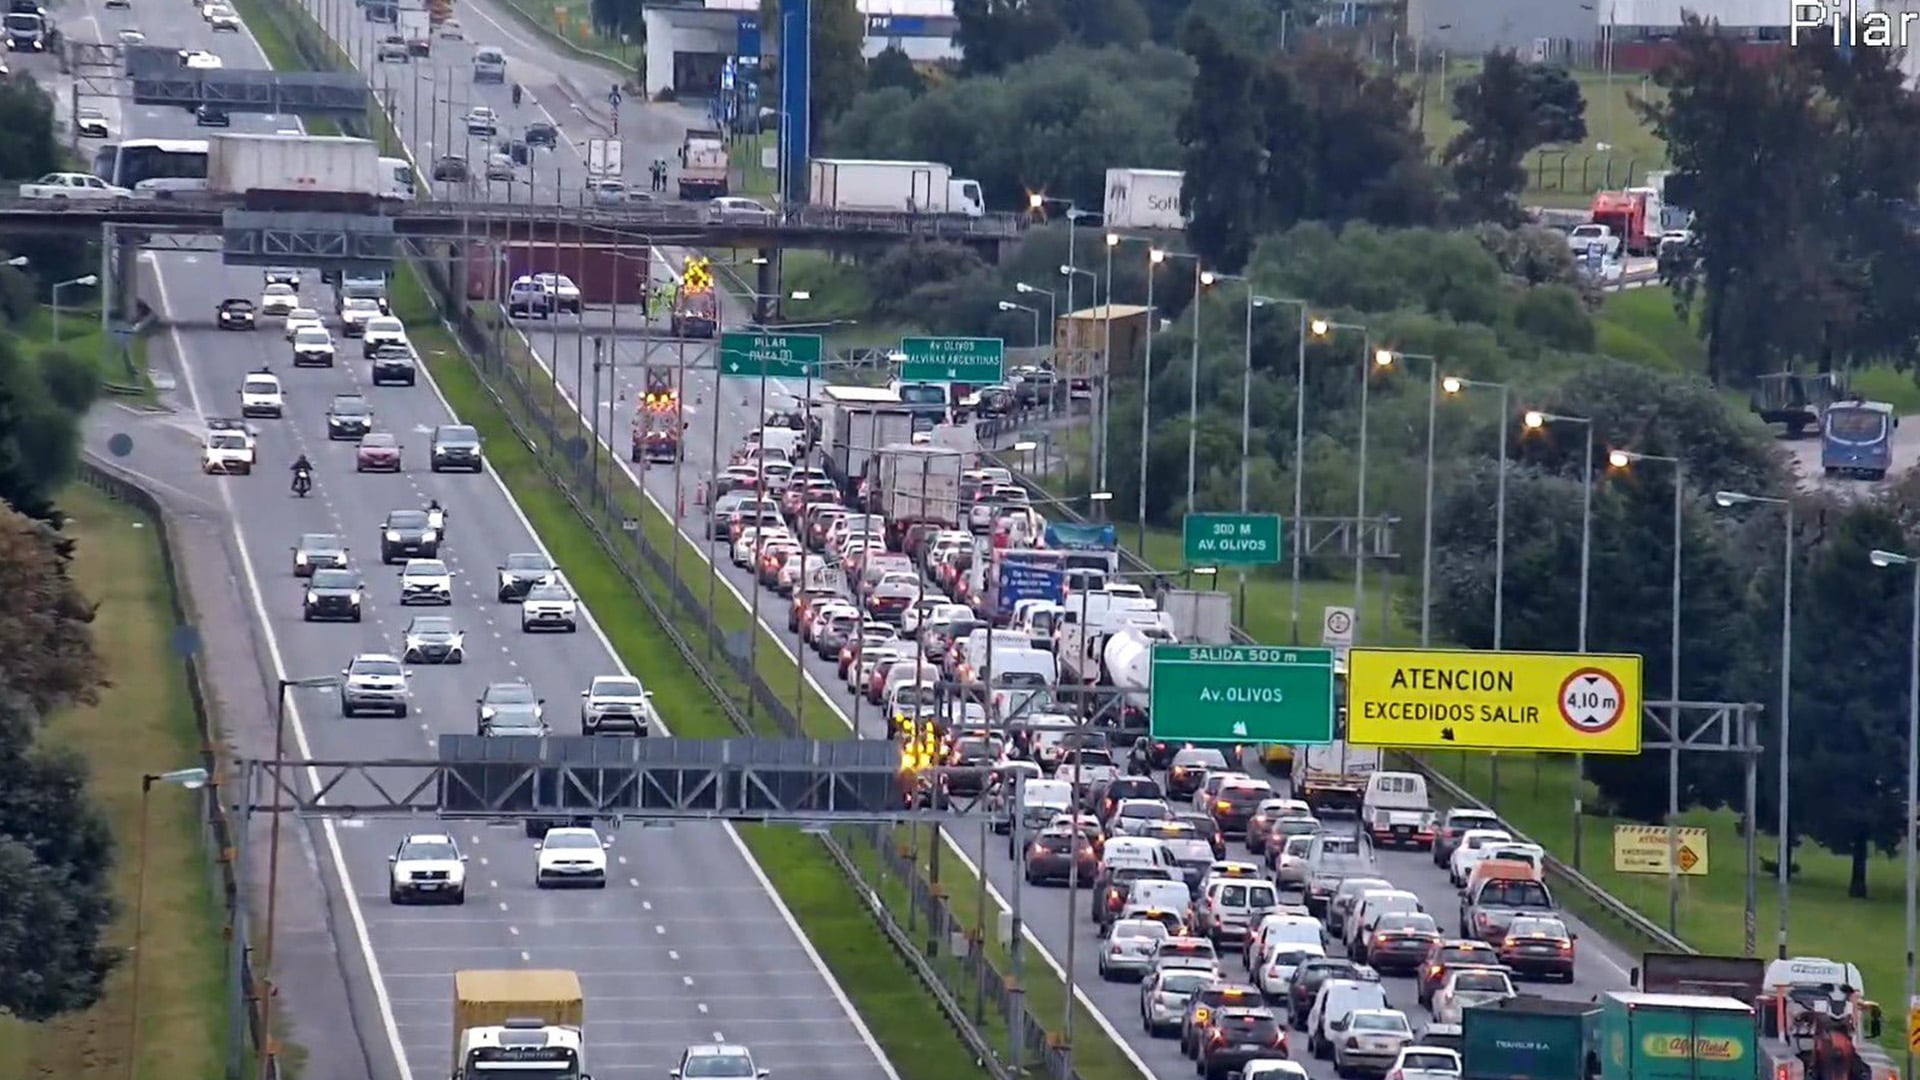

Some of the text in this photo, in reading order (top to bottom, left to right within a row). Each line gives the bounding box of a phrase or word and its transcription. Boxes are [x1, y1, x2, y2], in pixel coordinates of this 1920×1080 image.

[754, 337, 787, 348] PILAR
[943, 341, 976, 352] OLIVOS
[904, 353, 1000, 366] ALVINAS ARGENTINAS
[1213, 523, 1252, 535] 300 M
[1198, 539, 1267, 551] AV. OLIVOS
[1189, 648, 1297, 662] SALIDA 500 m
[1391, 668, 1514, 692] ATENCION
[1200, 686, 1283, 702] Av. OLIVOS
[1602, 697, 1616, 709] m
[1364, 702, 1539, 724] EXCEDIDOS SALIR
